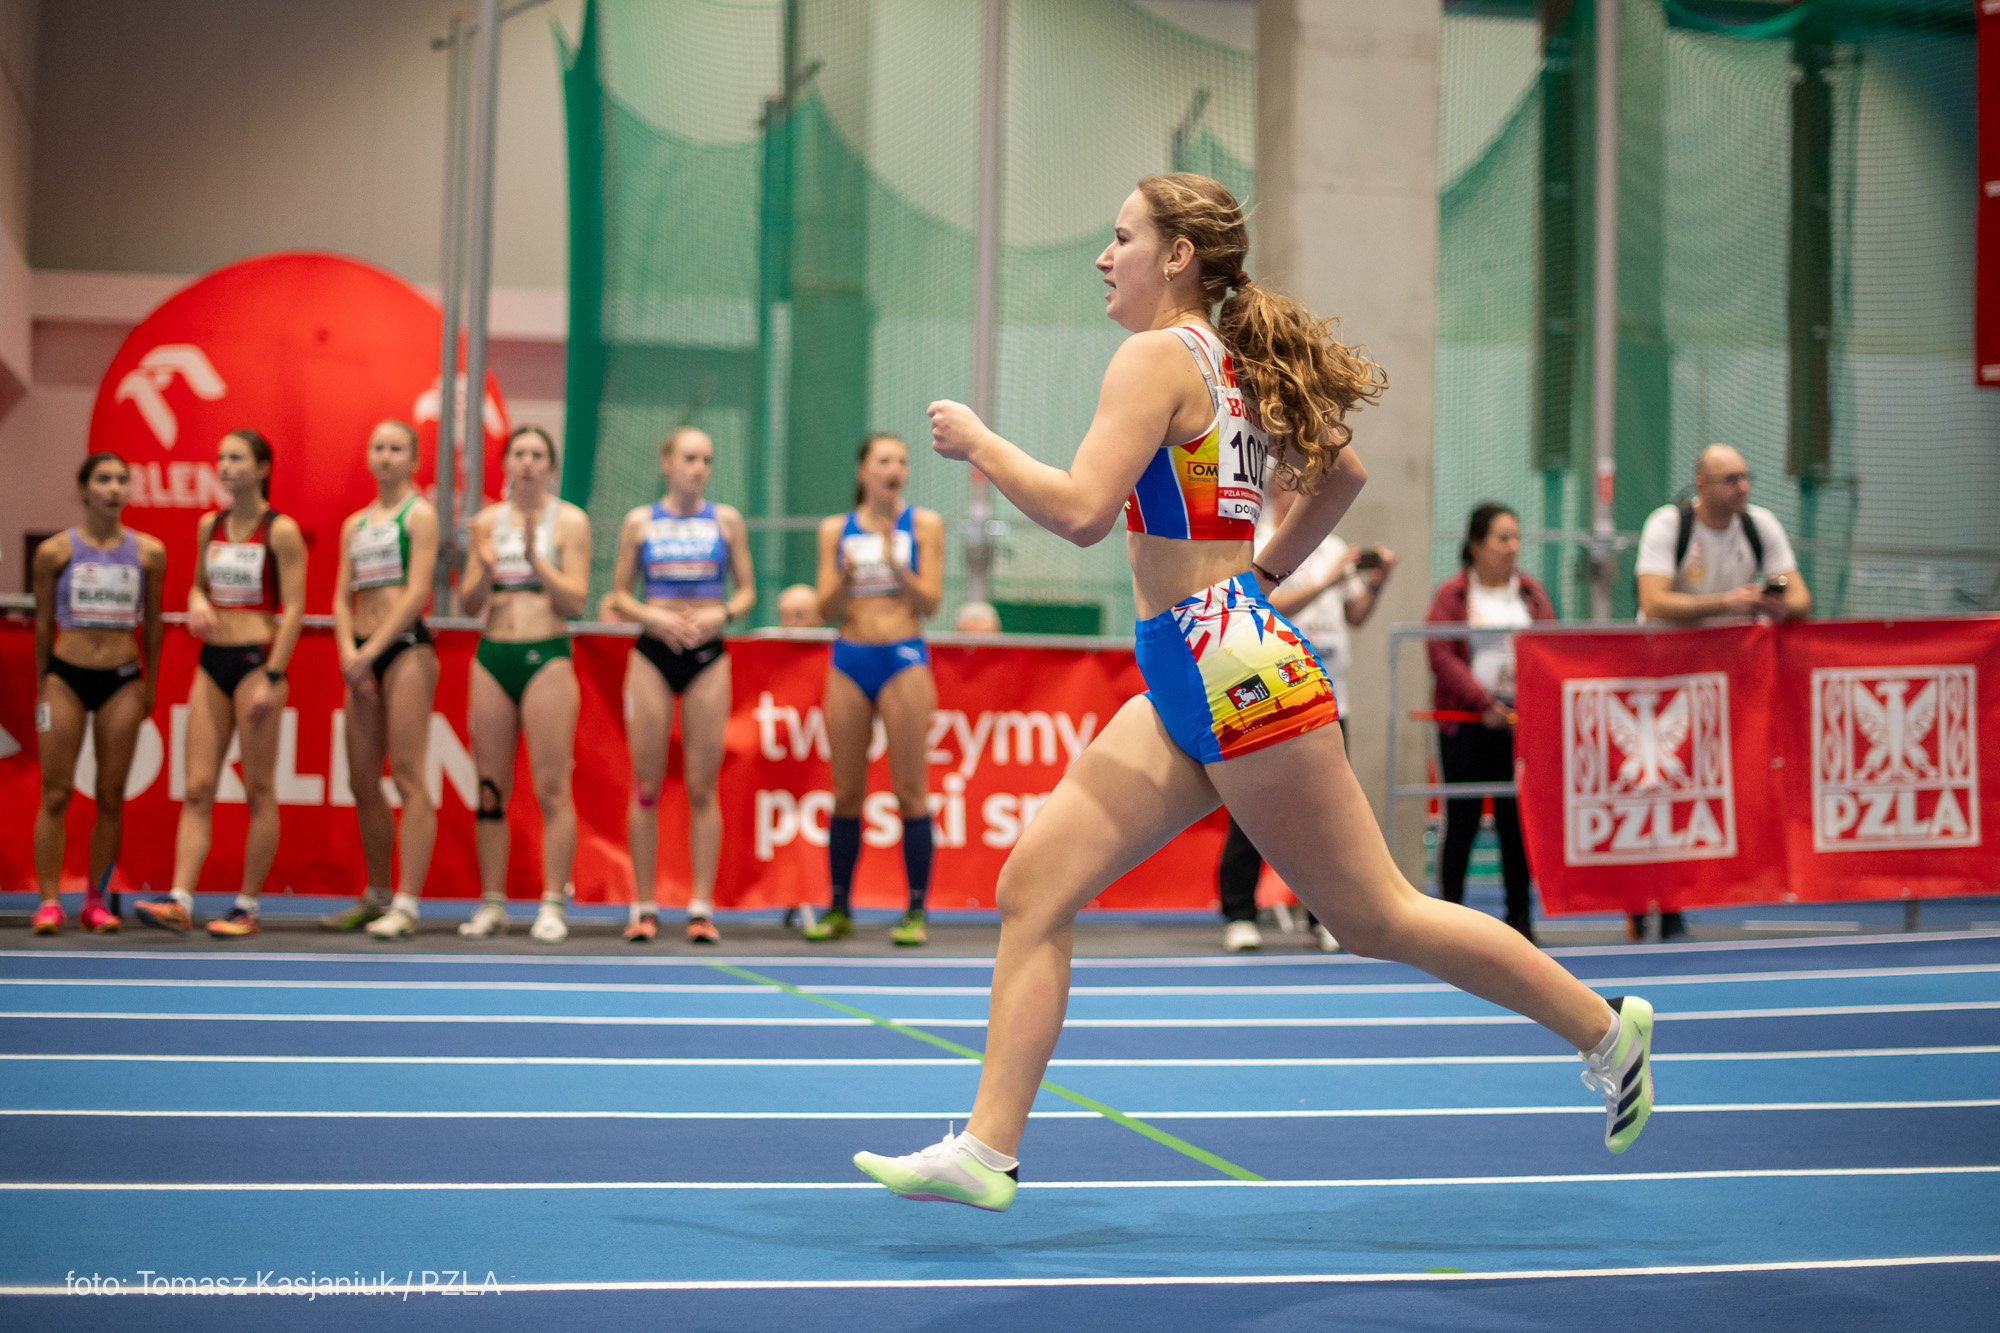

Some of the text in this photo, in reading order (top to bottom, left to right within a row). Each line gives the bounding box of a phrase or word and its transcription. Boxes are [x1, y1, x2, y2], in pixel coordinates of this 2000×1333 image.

[128, 461, 234, 508] RLEN
[752, 690, 1099, 779] twzymy
[754, 771, 968, 862] posi
[1578, 799, 1727, 851] PZLA
[1823, 787, 1971, 838] PZLA
